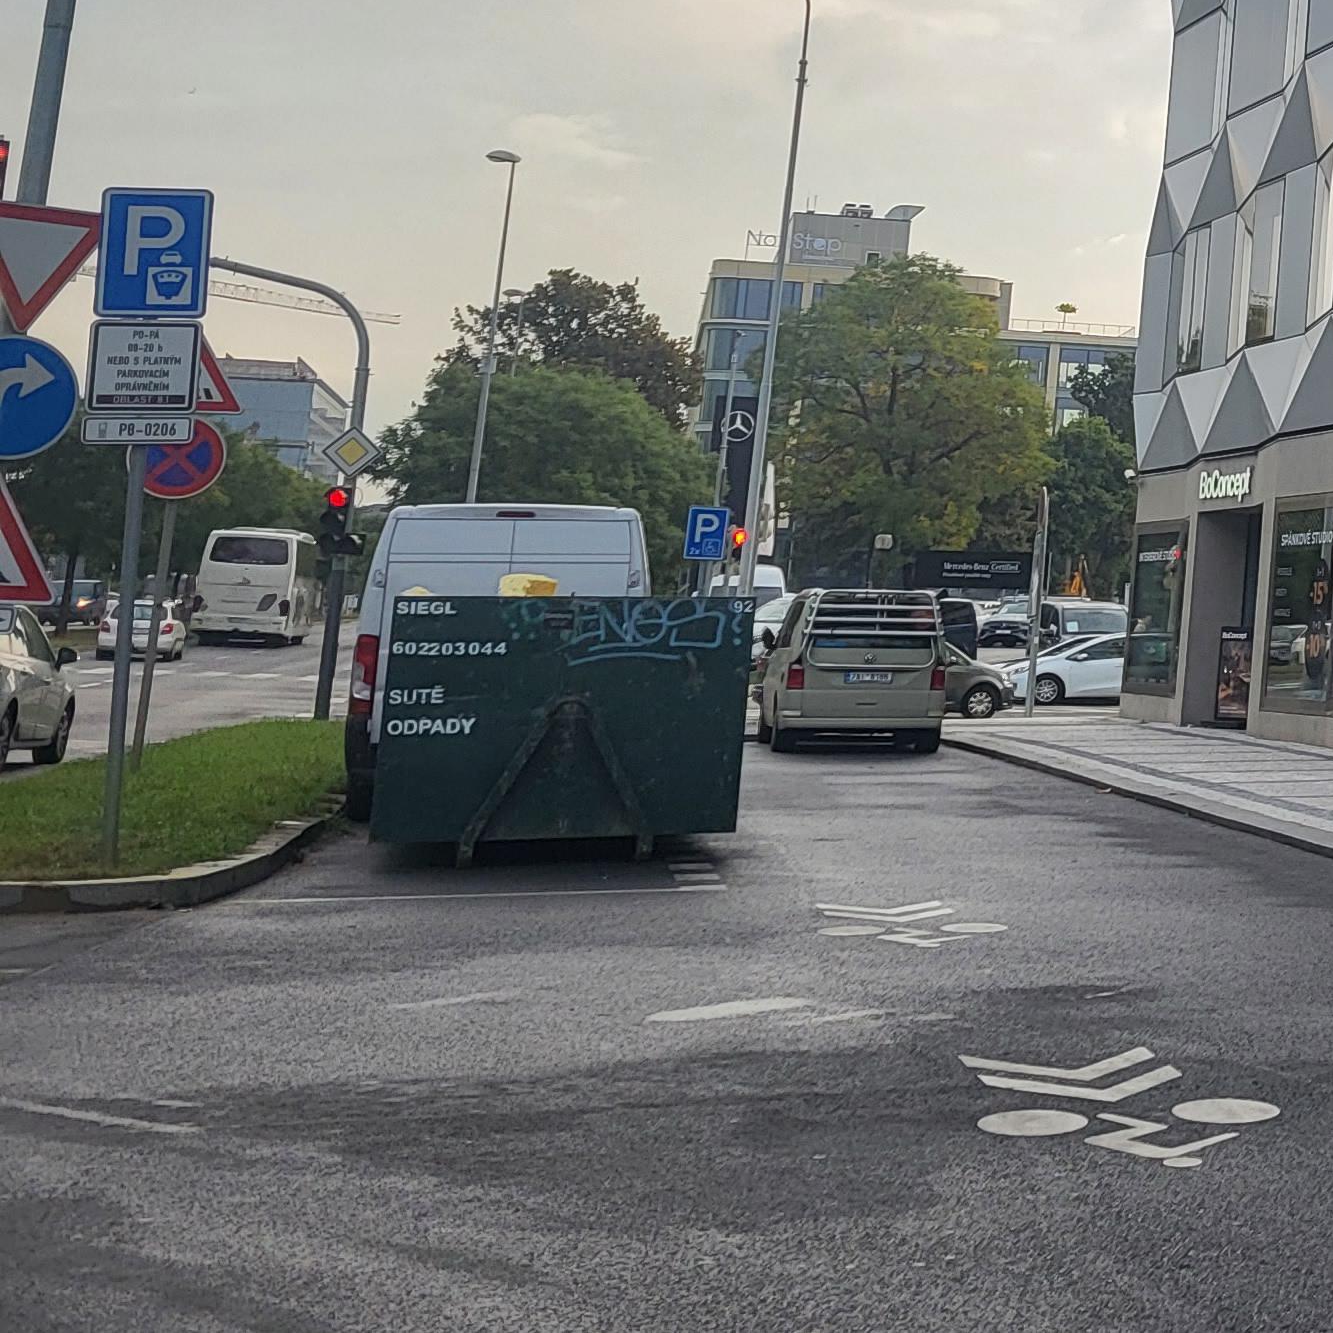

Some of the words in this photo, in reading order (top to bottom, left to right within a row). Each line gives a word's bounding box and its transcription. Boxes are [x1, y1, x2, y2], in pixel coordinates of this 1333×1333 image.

[123, 205, 186, 276] P
[107, 356, 130, 366] NEBO
[133, 356, 140, 366] S
[143, 354, 182, 366] PLATNÝM
[117, 368, 170, 379] PARKOVACÍM
[114, 380, 170, 392] OPRÁVNĚNÍM
[118, 423, 177, 437] P8-0206
[1199, 467, 1251, 503] BoConcept
[694, 513, 720, 544] P
[1281, 530, 1311, 547] SPÁNKOVÉ
[1311, 530, 1333, 545] STUDIO
[396, 601, 457, 615] SIEGL
[733, 600, 754, 614] 92
[392, 641, 507, 656] 602203044
[386, 717, 477, 736] ODPADY
